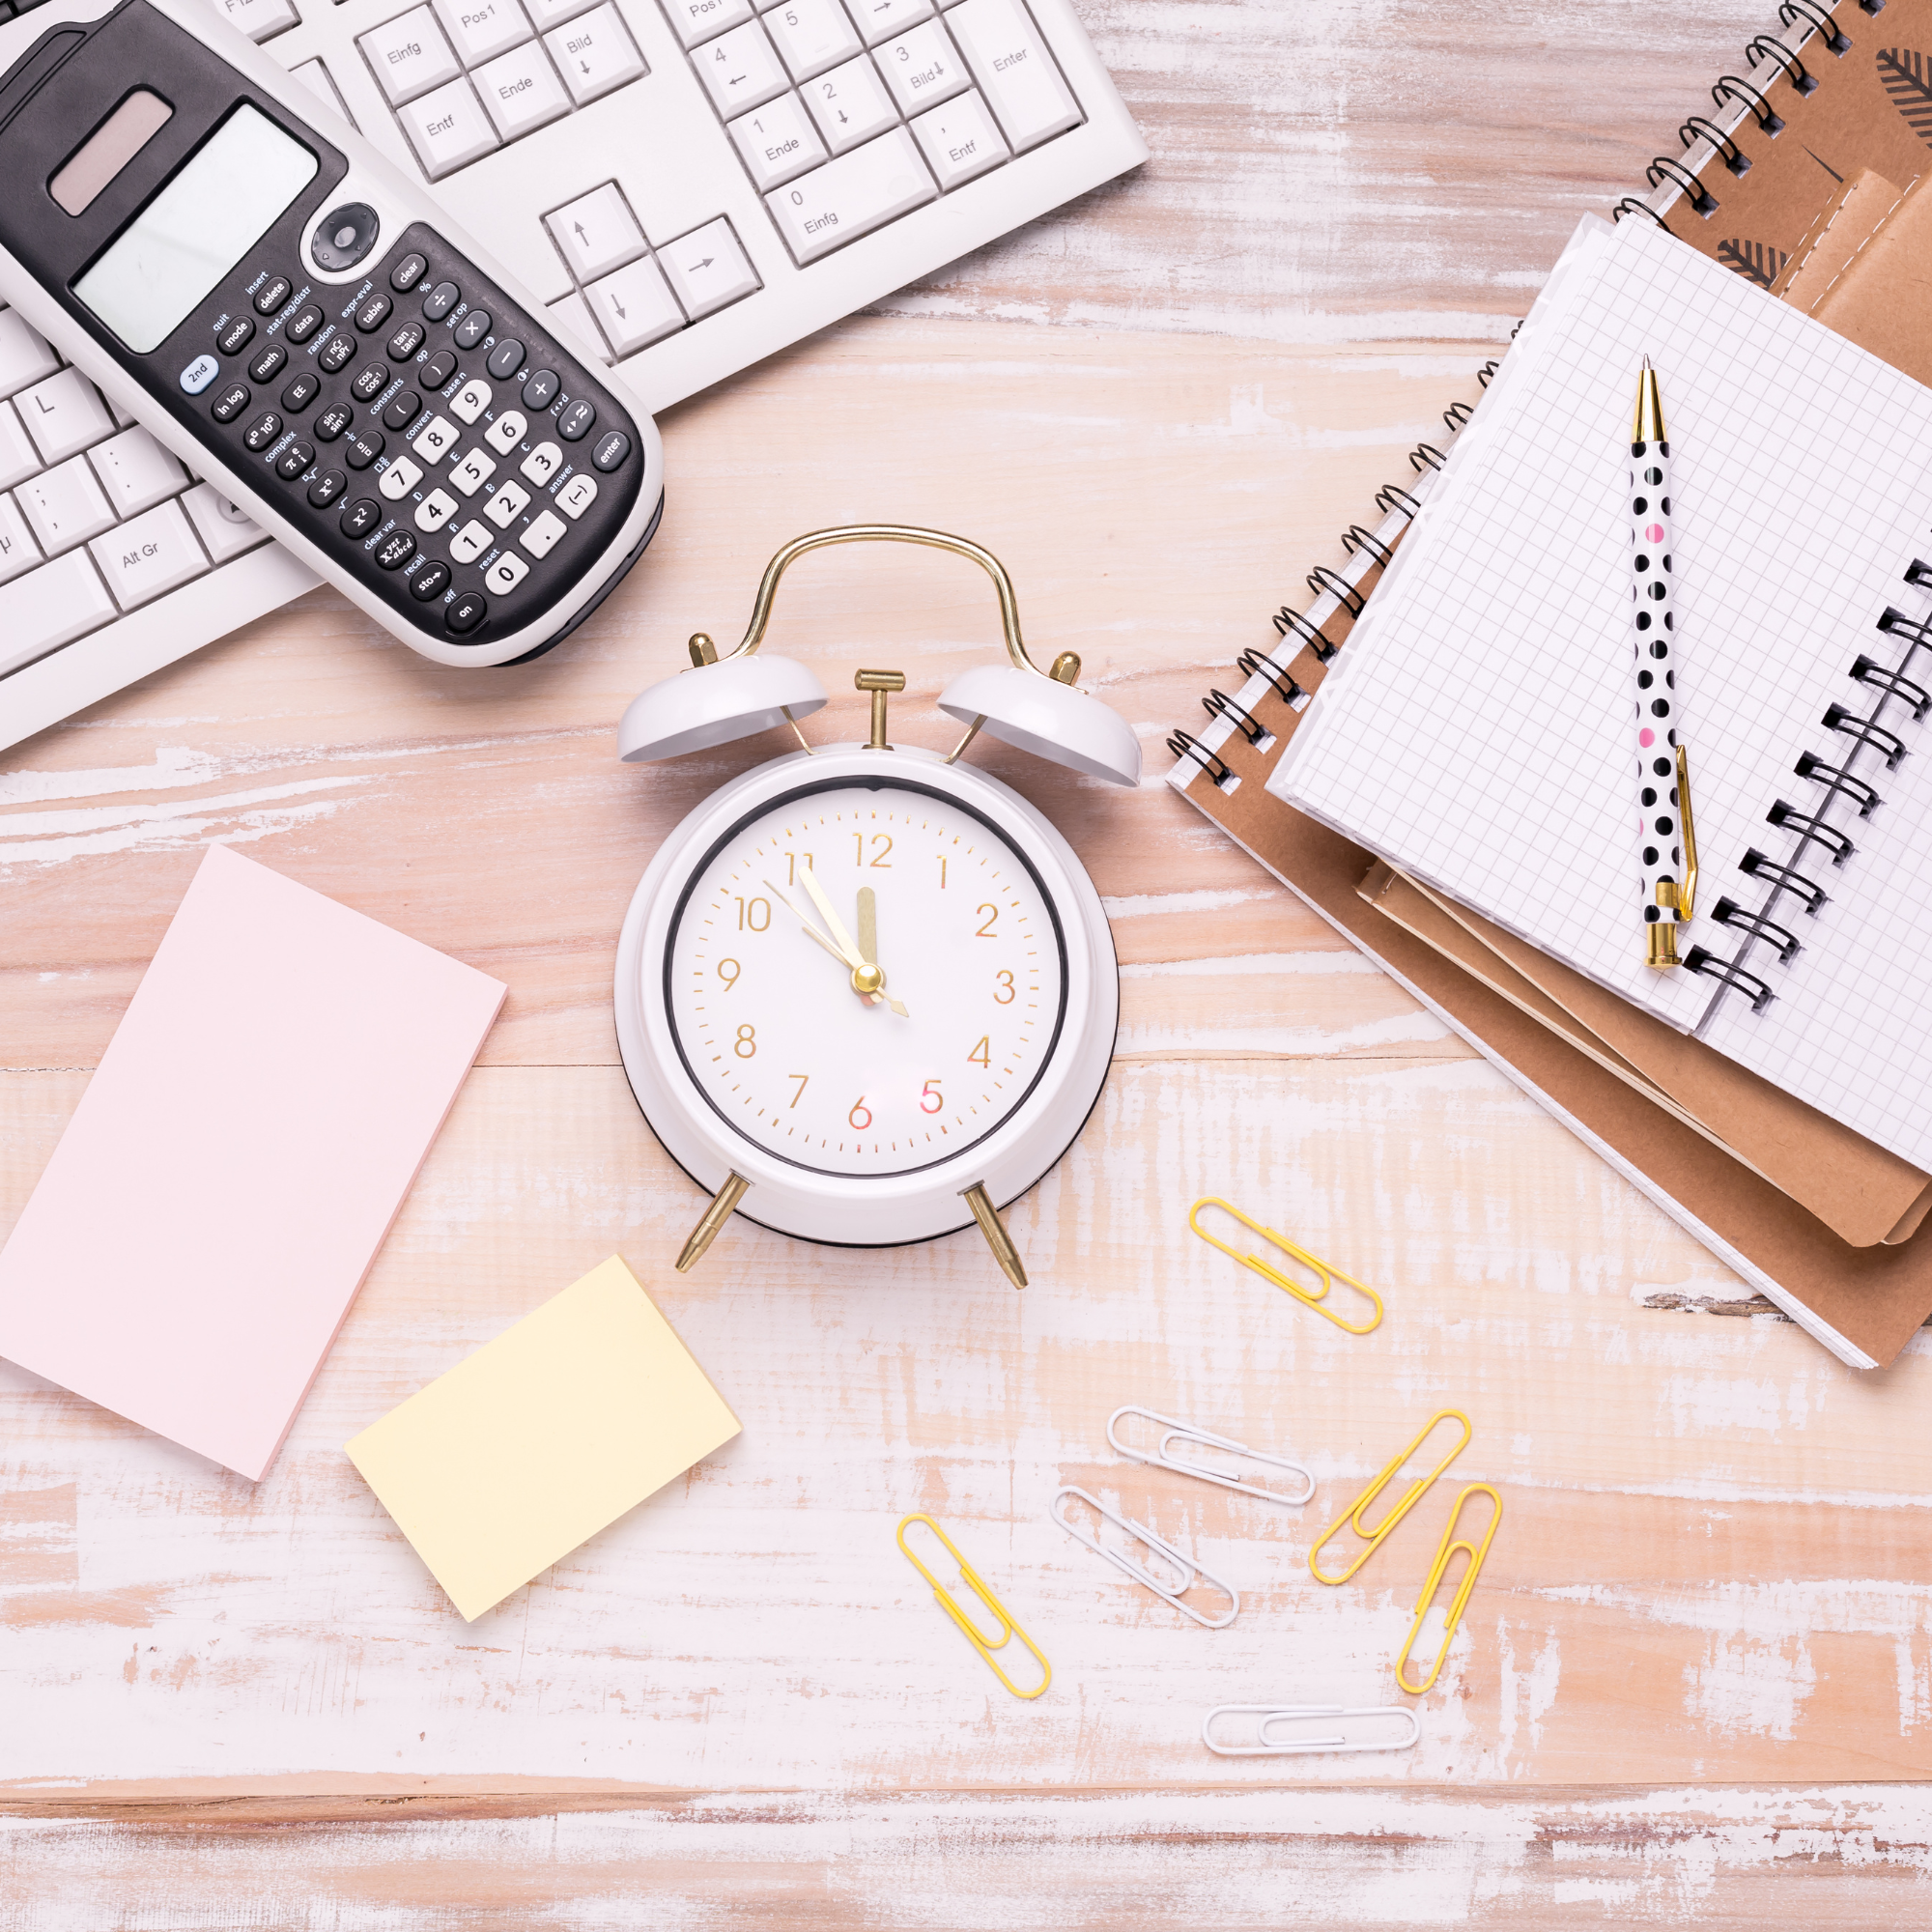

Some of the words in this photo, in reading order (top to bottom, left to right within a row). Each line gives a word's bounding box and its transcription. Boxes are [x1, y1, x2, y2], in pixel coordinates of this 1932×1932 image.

[462, 4, 497, 29] Pos1
[786, 12, 798, 27] 5
[386, 40, 422, 66] Einfg
[566, 34, 593, 54] Bild
[897, 46, 910, 62] 3
[715, 47, 726, 64] 4
[993, 46, 1029, 72] Enter
[499, 75, 534, 100] Ende
[823, 83, 837, 99] 2
[910, 69, 936, 91] Bild
[426, 114, 456, 138] Entf
[753, 118, 765, 133] 1
[765, 137, 800, 161] Ende
[949, 140, 978, 162] Entf
[791, 190, 804, 206] 0
[804, 210, 839, 235] Einfg
[244, 270, 269, 296] insert
[400, 262, 418, 284] clear
[260, 282, 285, 309] delete
[419, 282, 432, 293] %
[266, 285, 311, 335] stat-reg/distr
[341, 280, 373, 319] expr-eval
[213, 313, 230, 332] quit
[363, 300, 384, 324] table
[446, 314, 459, 327] set
[456, 302, 468, 317] op
[225, 322, 248, 348] mode
[295, 315, 314, 333] data
[307, 324, 336, 355] random
[329, 337, 344, 354] nCr
[393, 330, 410, 346] tan
[257, 352, 279, 375] math
[336, 345, 351, 361] nPr
[416, 349, 429, 362] op
[188, 363, 209, 383] 2nd
[357, 371, 373, 386] cos
[293, 384, 307, 399] EE
[370, 378, 405, 415] constants
[441, 382, 458, 398] base
[457, 374, 467, 383] n
[35, 395, 54, 413] L
[228, 389, 244, 407] log
[465, 391, 480, 408] 9
[324, 412, 337, 427] sin
[405, 410, 434, 440] convert
[485, 411, 495, 421] F
[428, 432, 443, 448] 8
[501, 421, 516, 438] 6
[265, 431, 298, 463] complex
[450, 452, 460, 462] E
[521, 442, 530, 452] C
[600, 438, 621, 465] enter
[465, 464, 480, 480] 5
[535, 454, 552, 470] 3
[391, 470, 407, 487] 7
[486, 483, 496, 494] B
[548, 465, 574, 494] answer
[412, 492, 423, 501] D
[498, 497, 517, 514] 2
[427, 503, 442, 519] 4
[364, 530, 382, 551] clear
[379, 519, 396, 534] var
[464, 535, 478, 550] 1
[123, 551, 141, 568] Alt
[141, 542, 158, 556] Gr
[404, 554, 426, 577] recall
[478, 549, 499, 570] reset
[418, 576, 435, 591] sto
[498, 566, 515, 582] 0
[443, 589, 457, 604] off
[459, 605, 472, 618] on
[852, 833, 894, 869] 12
[784, 852, 813, 887] 11
[936, 855, 947, 889] 1
[734, 896, 772, 932] 10
[975, 903, 999, 938] 2
[717, 957, 741, 993] 9
[993, 970, 1016, 1006] 3
[733, 1024, 757, 1059] 8
[966, 1035, 992, 1069] 4
[787, 1073, 810, 1109] 7
[920, 1079, 944, 1114] 5
[848, 1094, 872, 1131] 6
